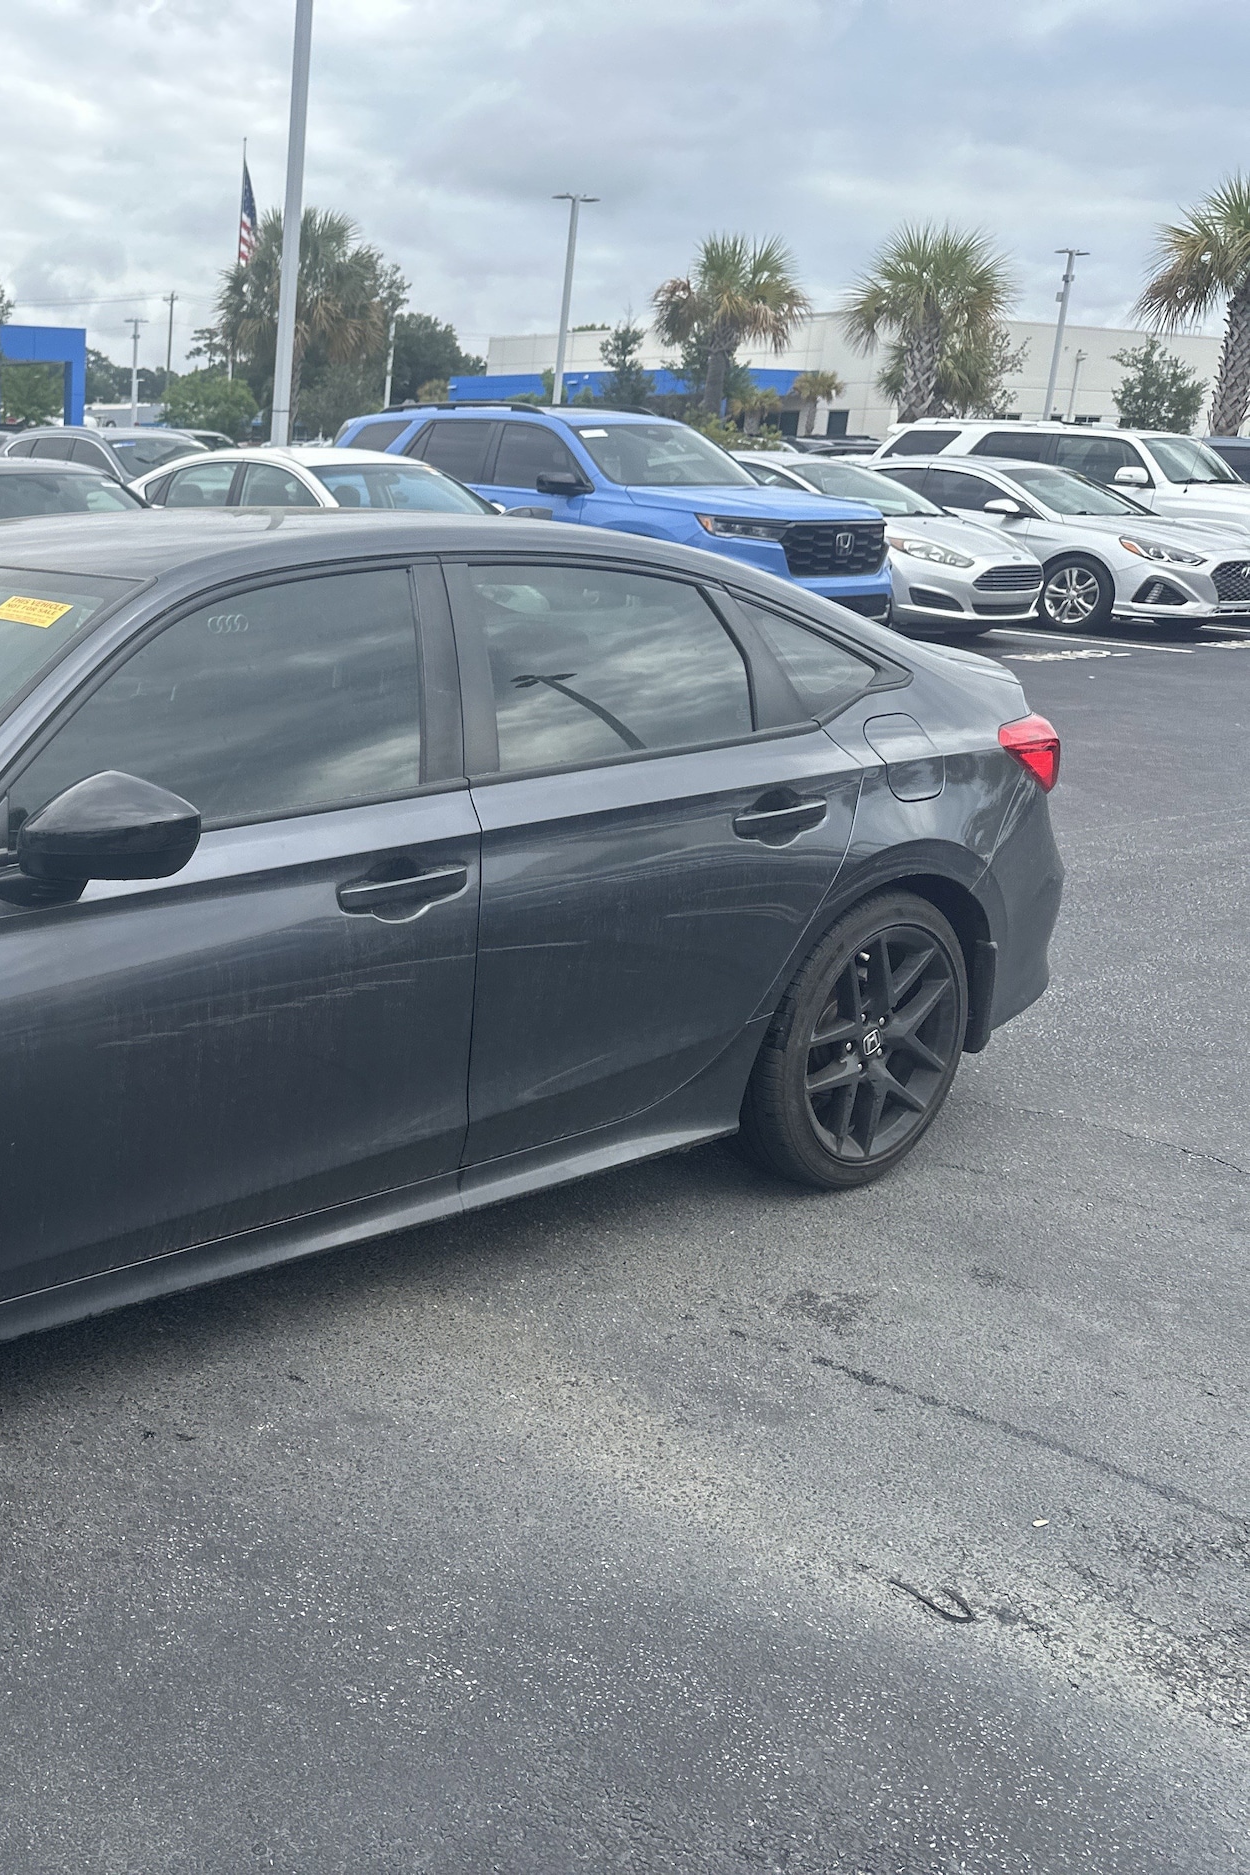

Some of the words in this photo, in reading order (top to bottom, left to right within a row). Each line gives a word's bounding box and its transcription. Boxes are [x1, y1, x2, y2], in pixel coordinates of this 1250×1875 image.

[10, 597, 31, 605] THIS
[31, 600, 67, 611] VEHICLE
[38, 608, 57, 616] SALE
